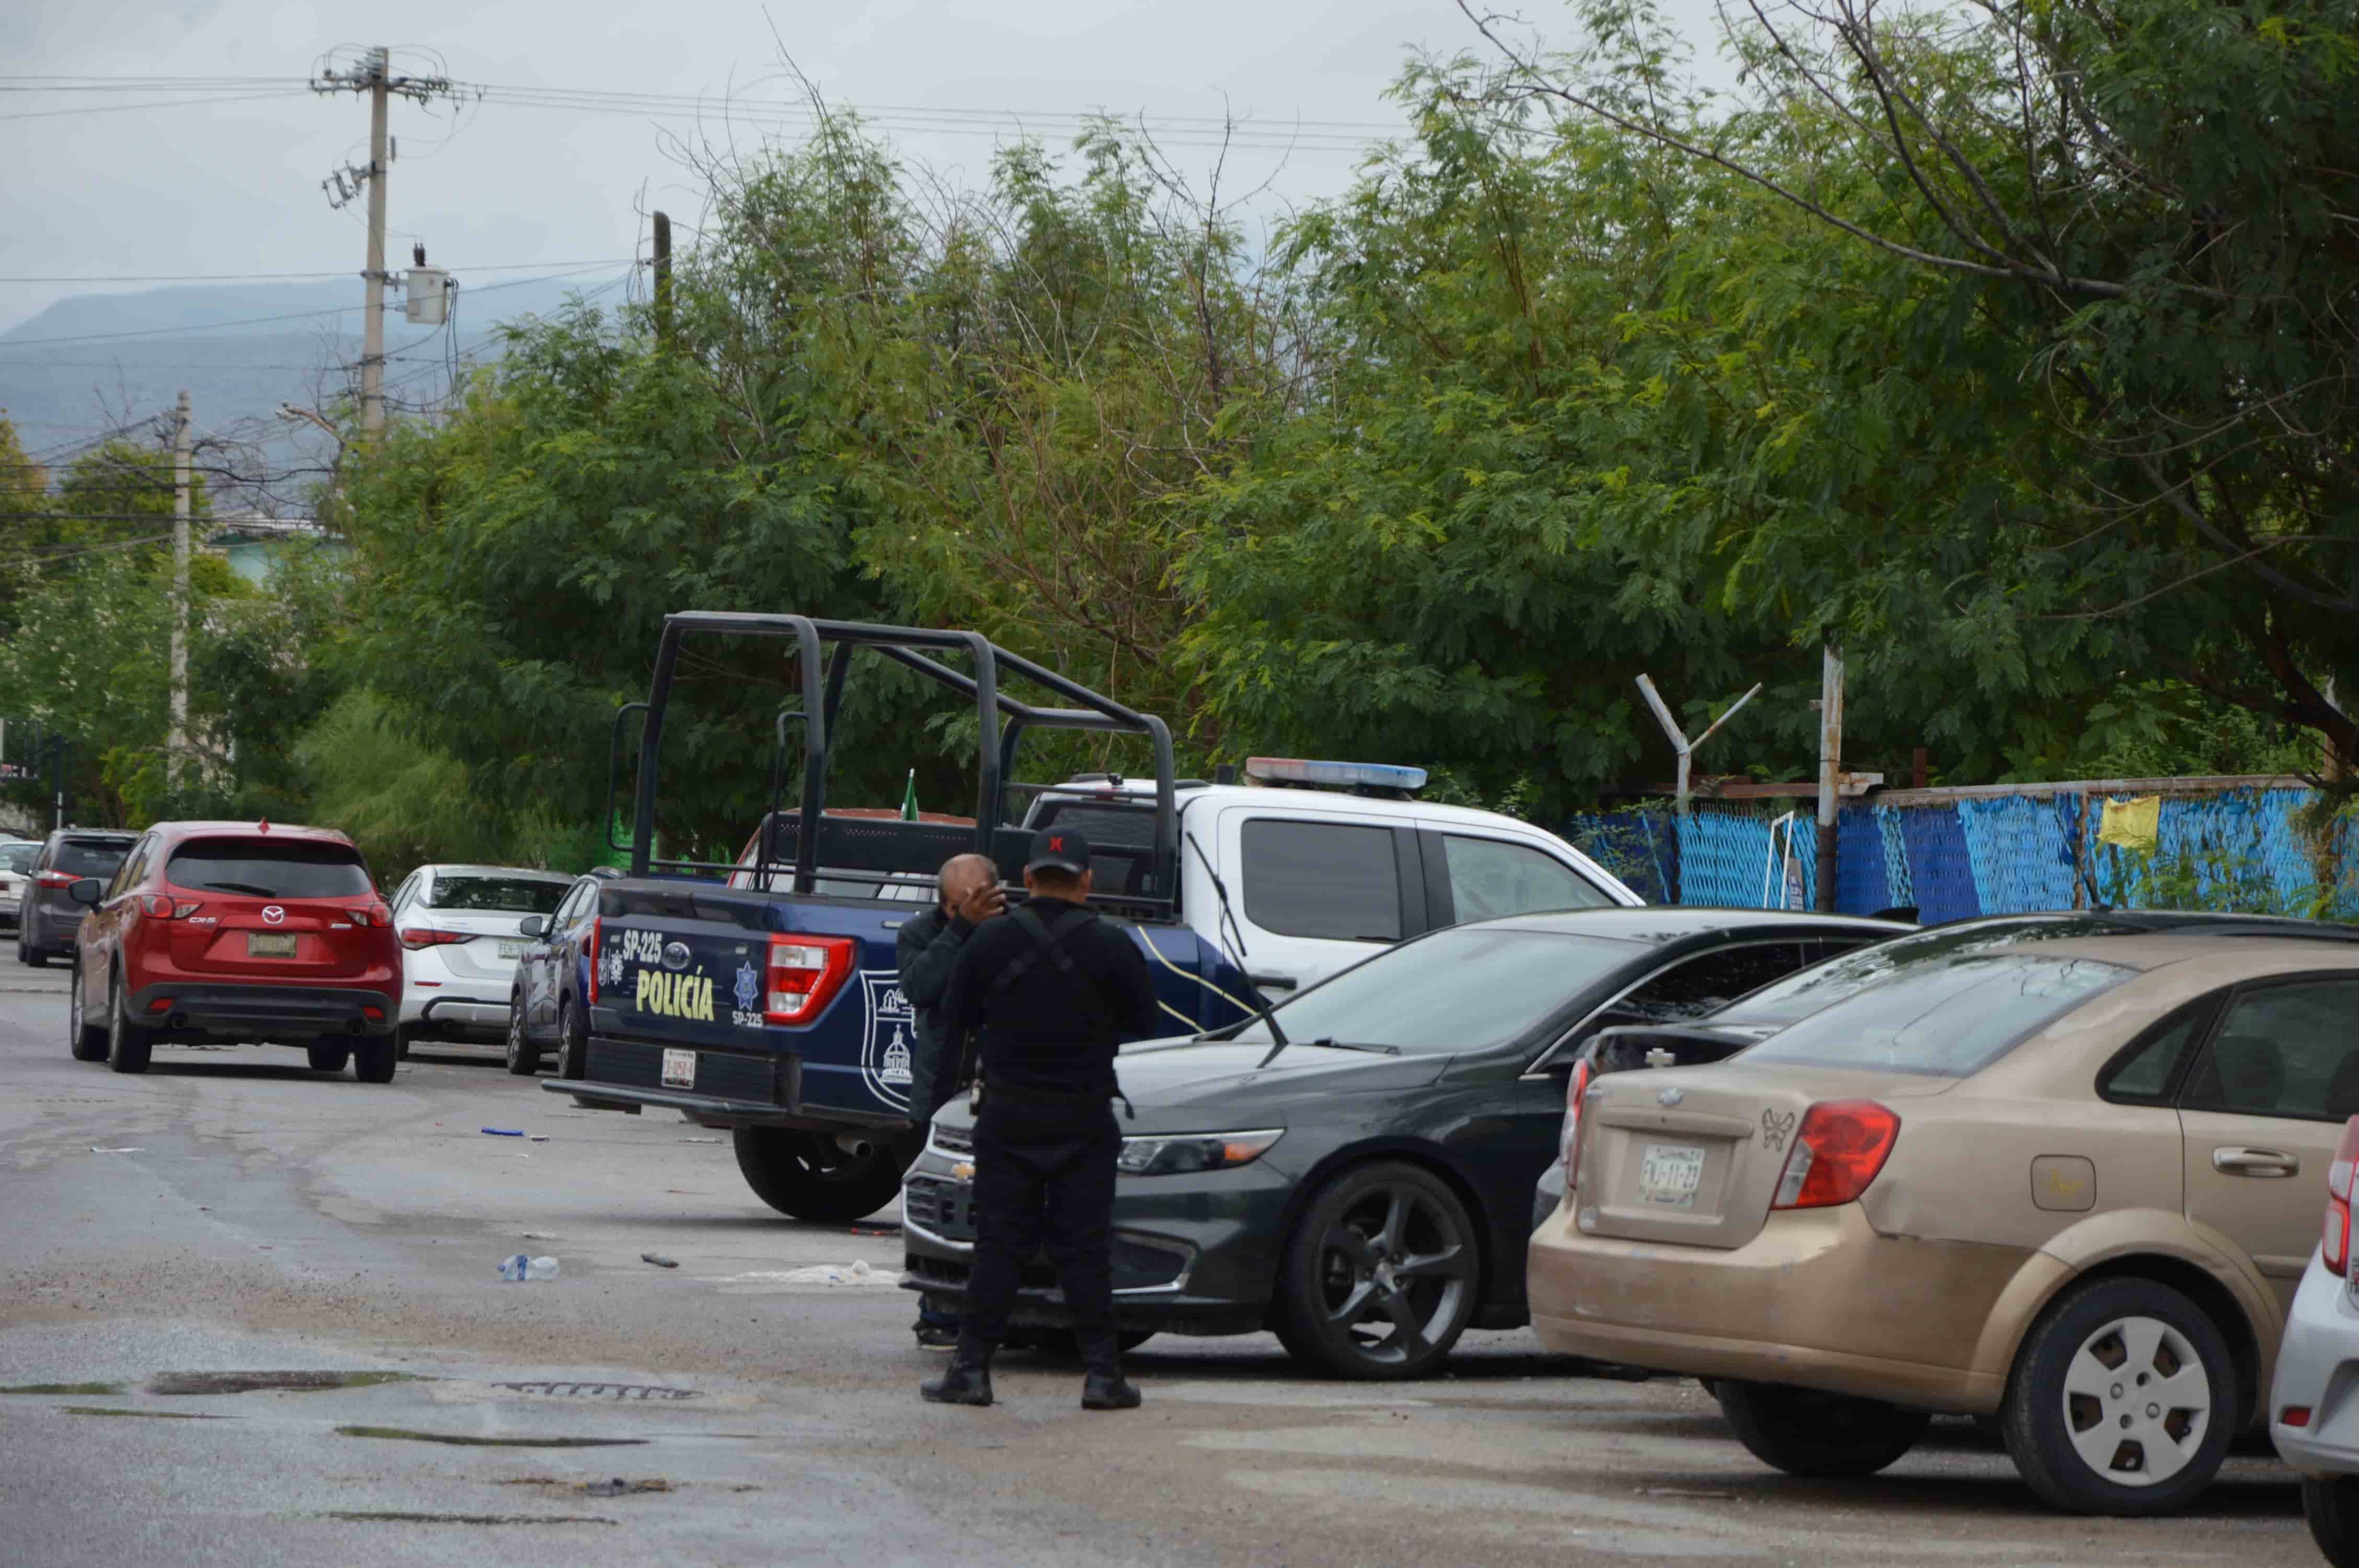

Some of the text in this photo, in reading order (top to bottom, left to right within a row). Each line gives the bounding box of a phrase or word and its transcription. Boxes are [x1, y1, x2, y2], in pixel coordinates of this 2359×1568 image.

[623, 929, 662, 964] SP-225
[636, 965, 715, 1021] POLICÍA
[732, 1010, 763, 1028] SP-225
